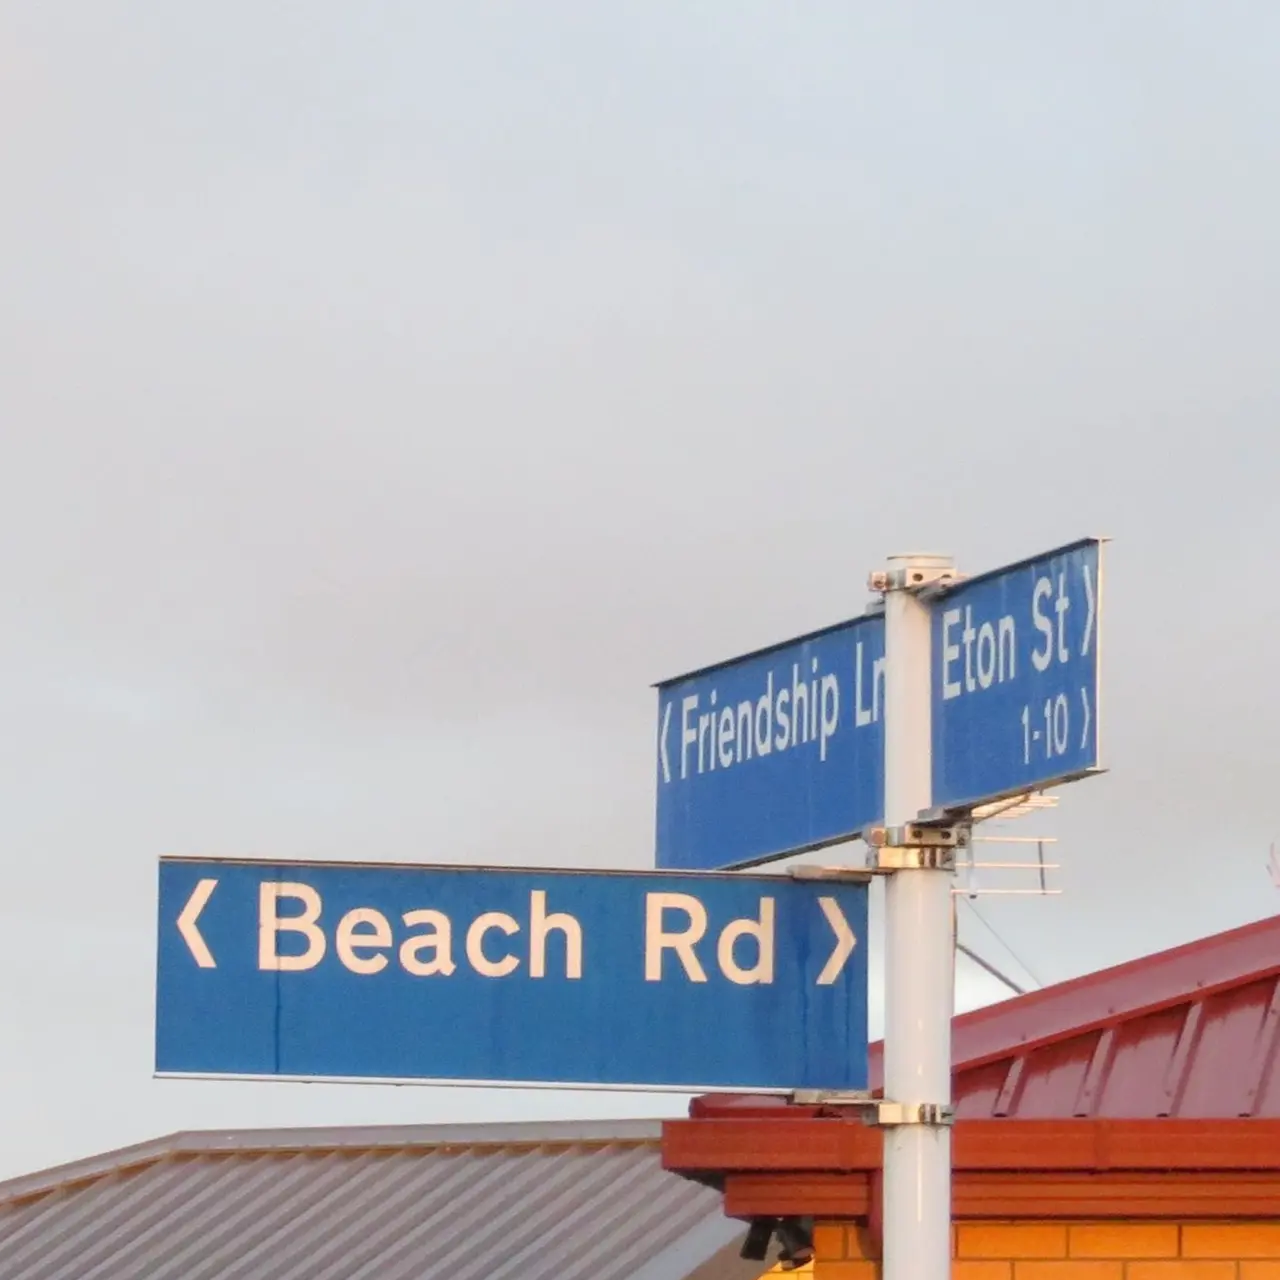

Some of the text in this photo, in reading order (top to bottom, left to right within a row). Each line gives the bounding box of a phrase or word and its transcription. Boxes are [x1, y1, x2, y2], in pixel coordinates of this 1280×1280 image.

[942, 571, 1070, 701] Eton St
[681, 656, 840, 762] Friendship
[1021, 692, 1069, 765] 1-10
[257, 880, 775, 986] Beach Rd
